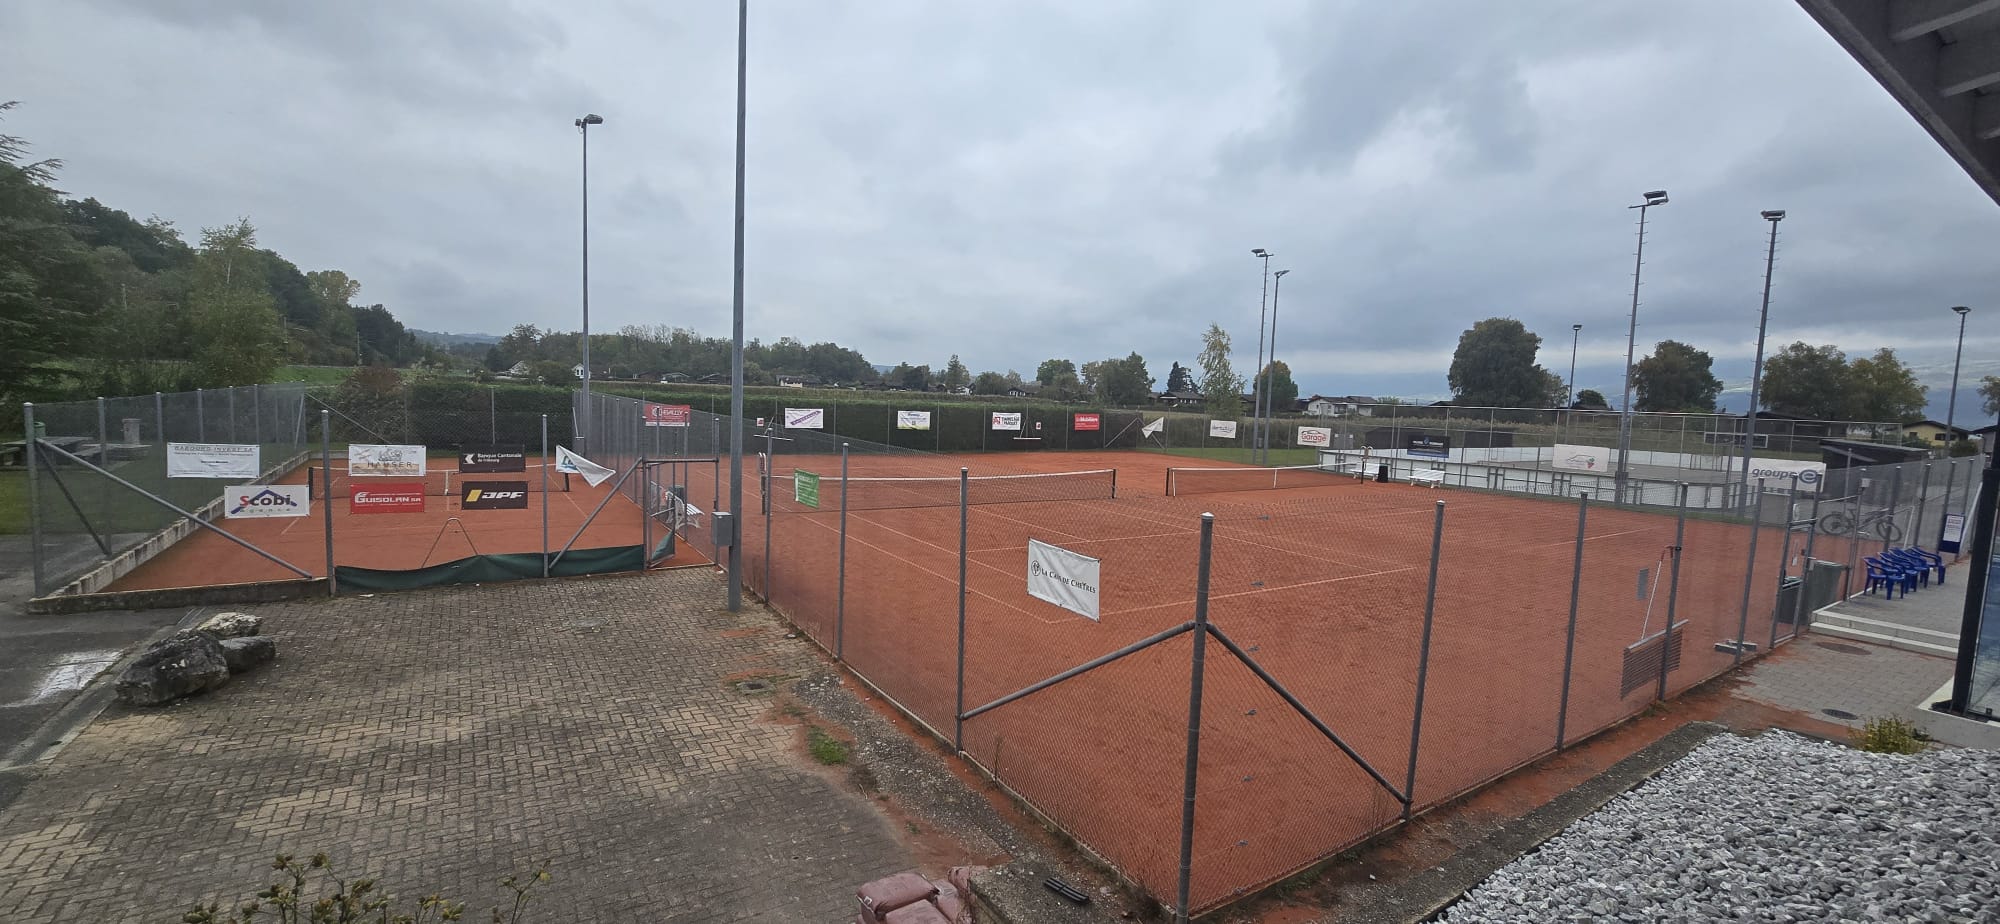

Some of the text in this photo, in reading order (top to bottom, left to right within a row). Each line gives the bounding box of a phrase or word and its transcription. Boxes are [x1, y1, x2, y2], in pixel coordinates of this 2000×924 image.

[1301, 433, 1326, 443] Garage
[239, 494, 291, 507] Scobi
[354, 492, 410, 504] GUISOLAN
[481, 491, 525, 499] JPF
